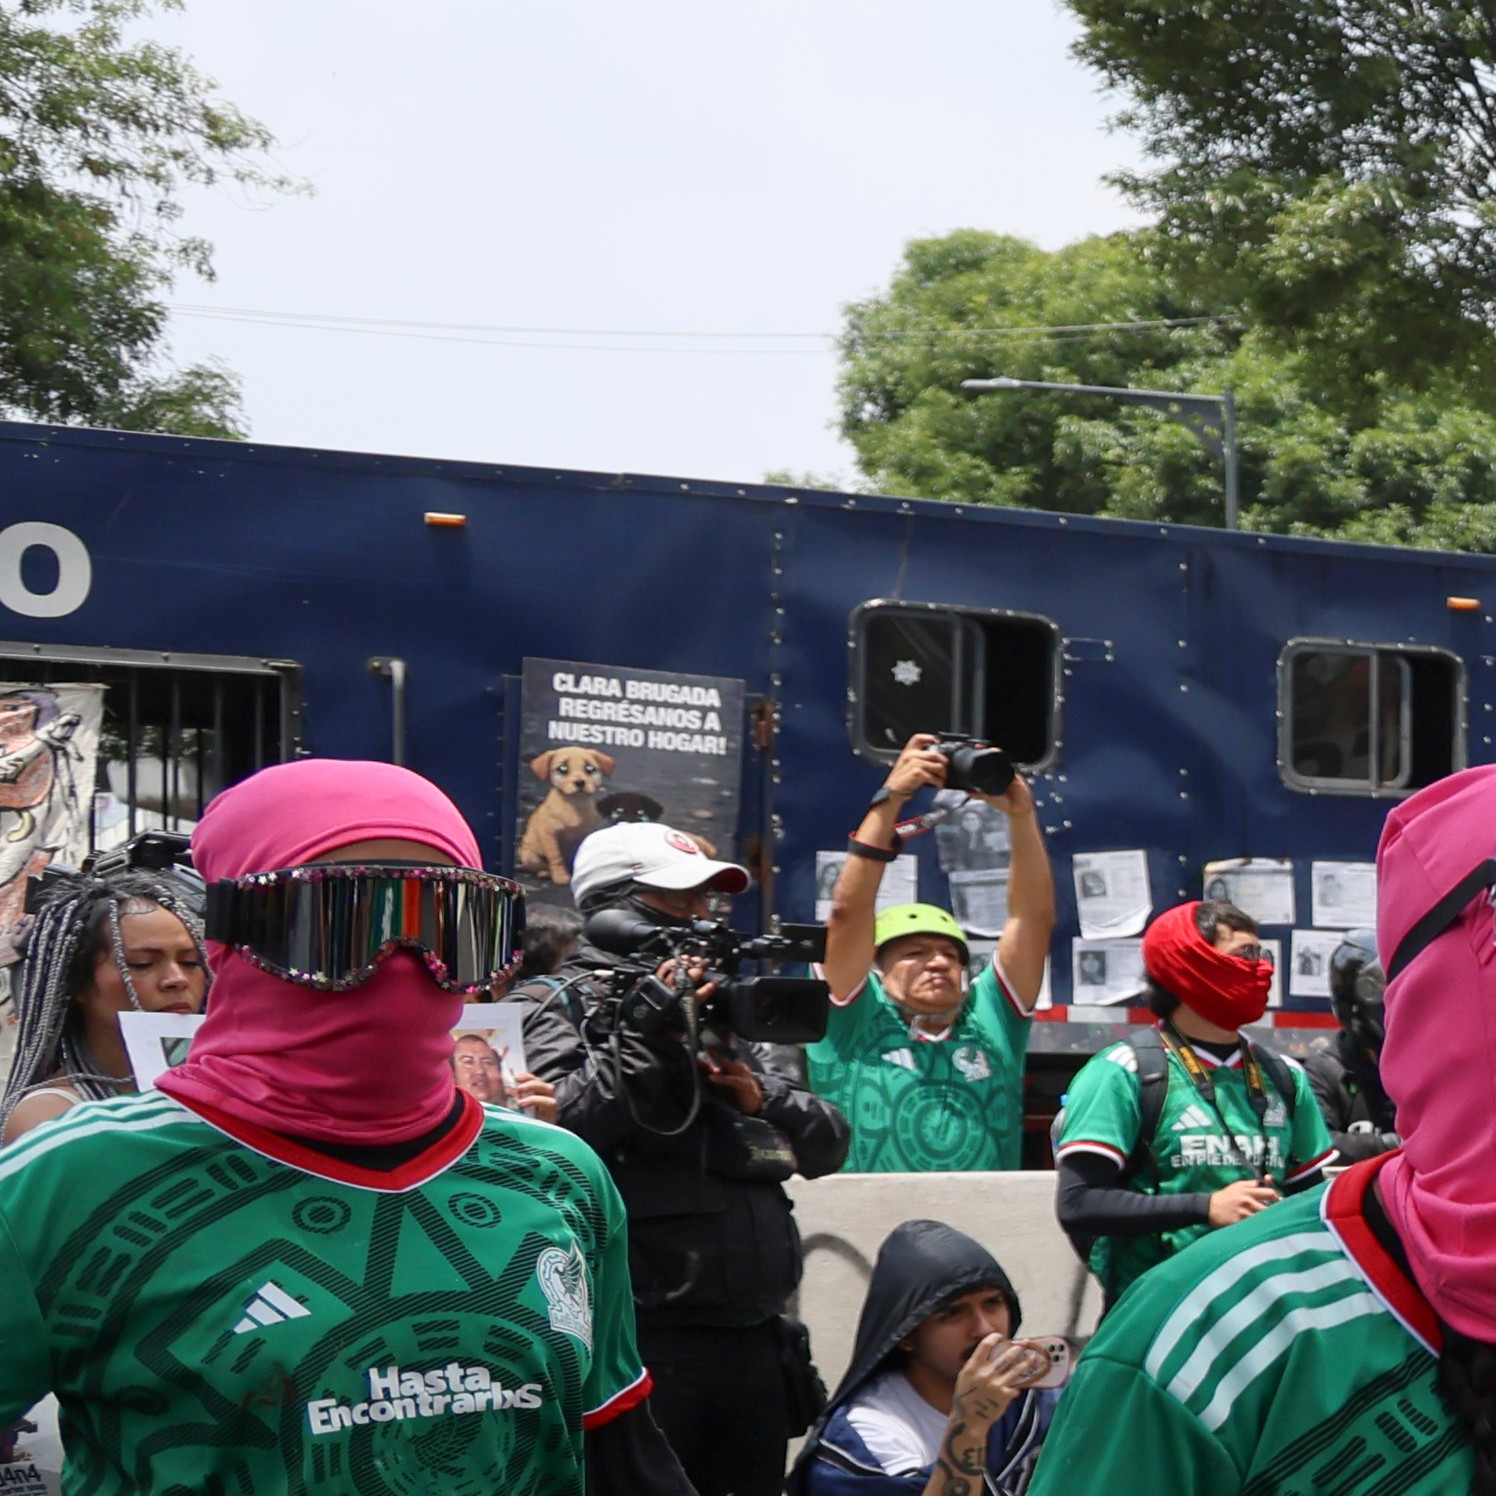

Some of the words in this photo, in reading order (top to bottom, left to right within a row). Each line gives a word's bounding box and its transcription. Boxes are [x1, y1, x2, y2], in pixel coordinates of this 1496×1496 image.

[552, 672, 623, 698] CLARA
[625, 679, 722, 708] BRUGADA
[558, 697, 701, 731] REGRÉSANOS
[703, 711, 722, 732] A
[548, 720, 646, 748] NUESTRO
[647, 730, 728, 756] HOGAR!
[368, 1361, 491, 1400] Hasta
